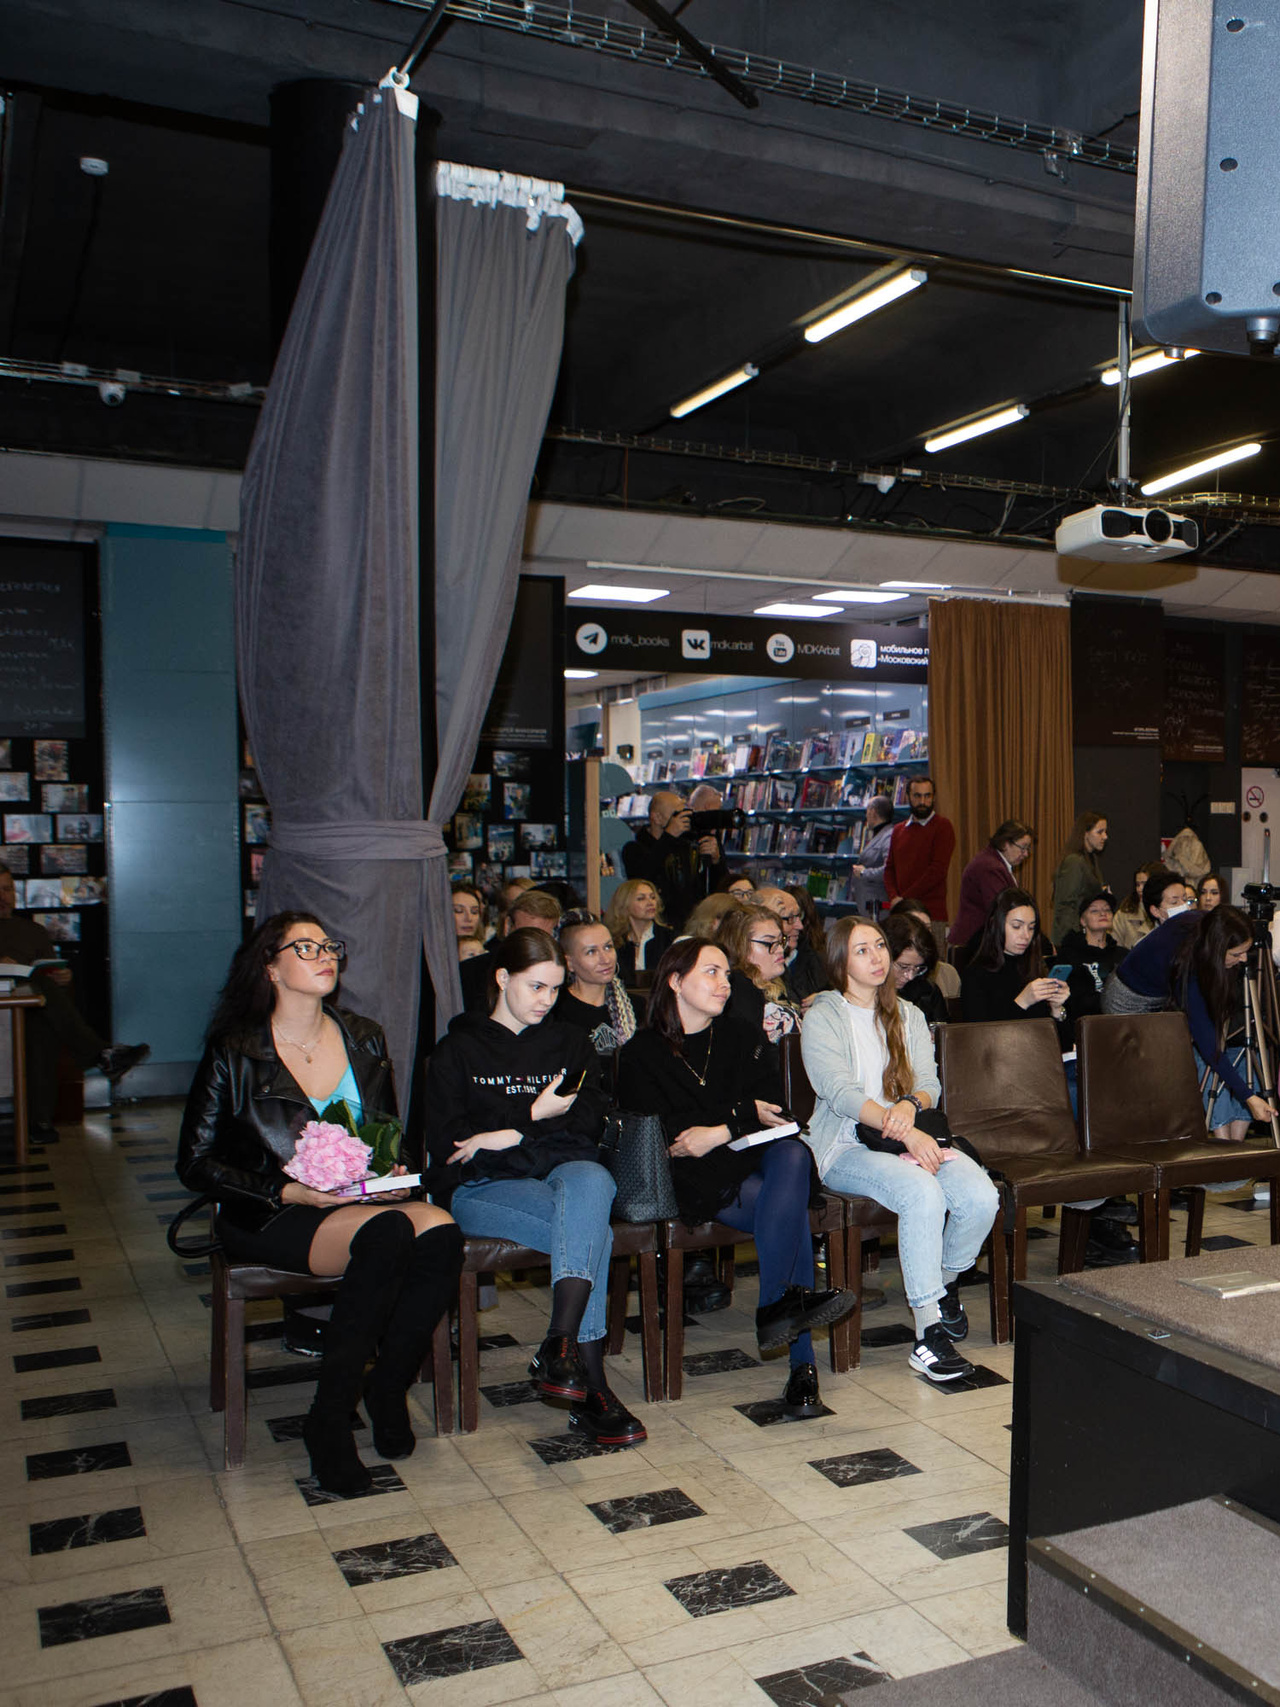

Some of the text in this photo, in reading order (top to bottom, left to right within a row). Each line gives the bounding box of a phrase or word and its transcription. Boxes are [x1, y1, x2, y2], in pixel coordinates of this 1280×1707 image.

[611, 633, 670, 648] mdk_books
[797, 643, 841, 657] MDKArbat
[880, 644, 923, 655] мобильное
[472, 1068, 567, 1086] TOMMY HILFIGR
